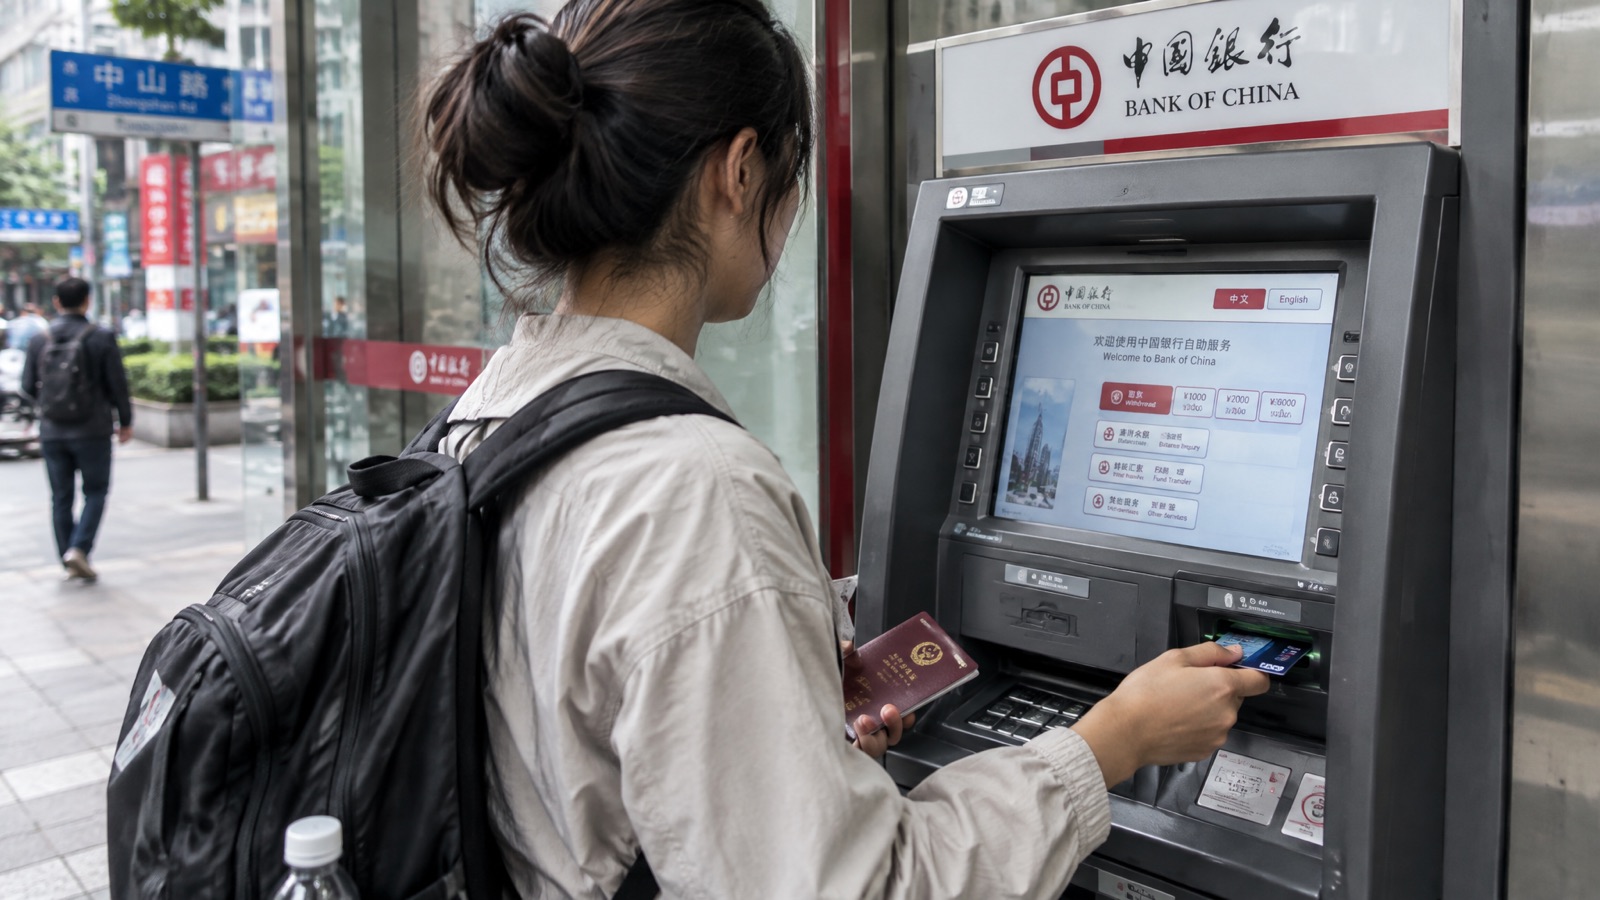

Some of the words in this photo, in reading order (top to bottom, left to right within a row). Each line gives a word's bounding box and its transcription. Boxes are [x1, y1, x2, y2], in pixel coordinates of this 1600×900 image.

[1125, 95, 1183, 117] BANK
[1188, 91, 1216, 110] OF
[1222, 82, 1301, 107] CHINA
[1229, 293, 1249, 305] 中文
[1279, 295, 1309, 305] English
[1103, 352, 1140, 363] Welcome
[1143, 354, 1152, 363] to
[1154, 354, 1176, 364] Bank
[1178, 355, 1189, 365] of
[1190, 356, 1216, 366] China
